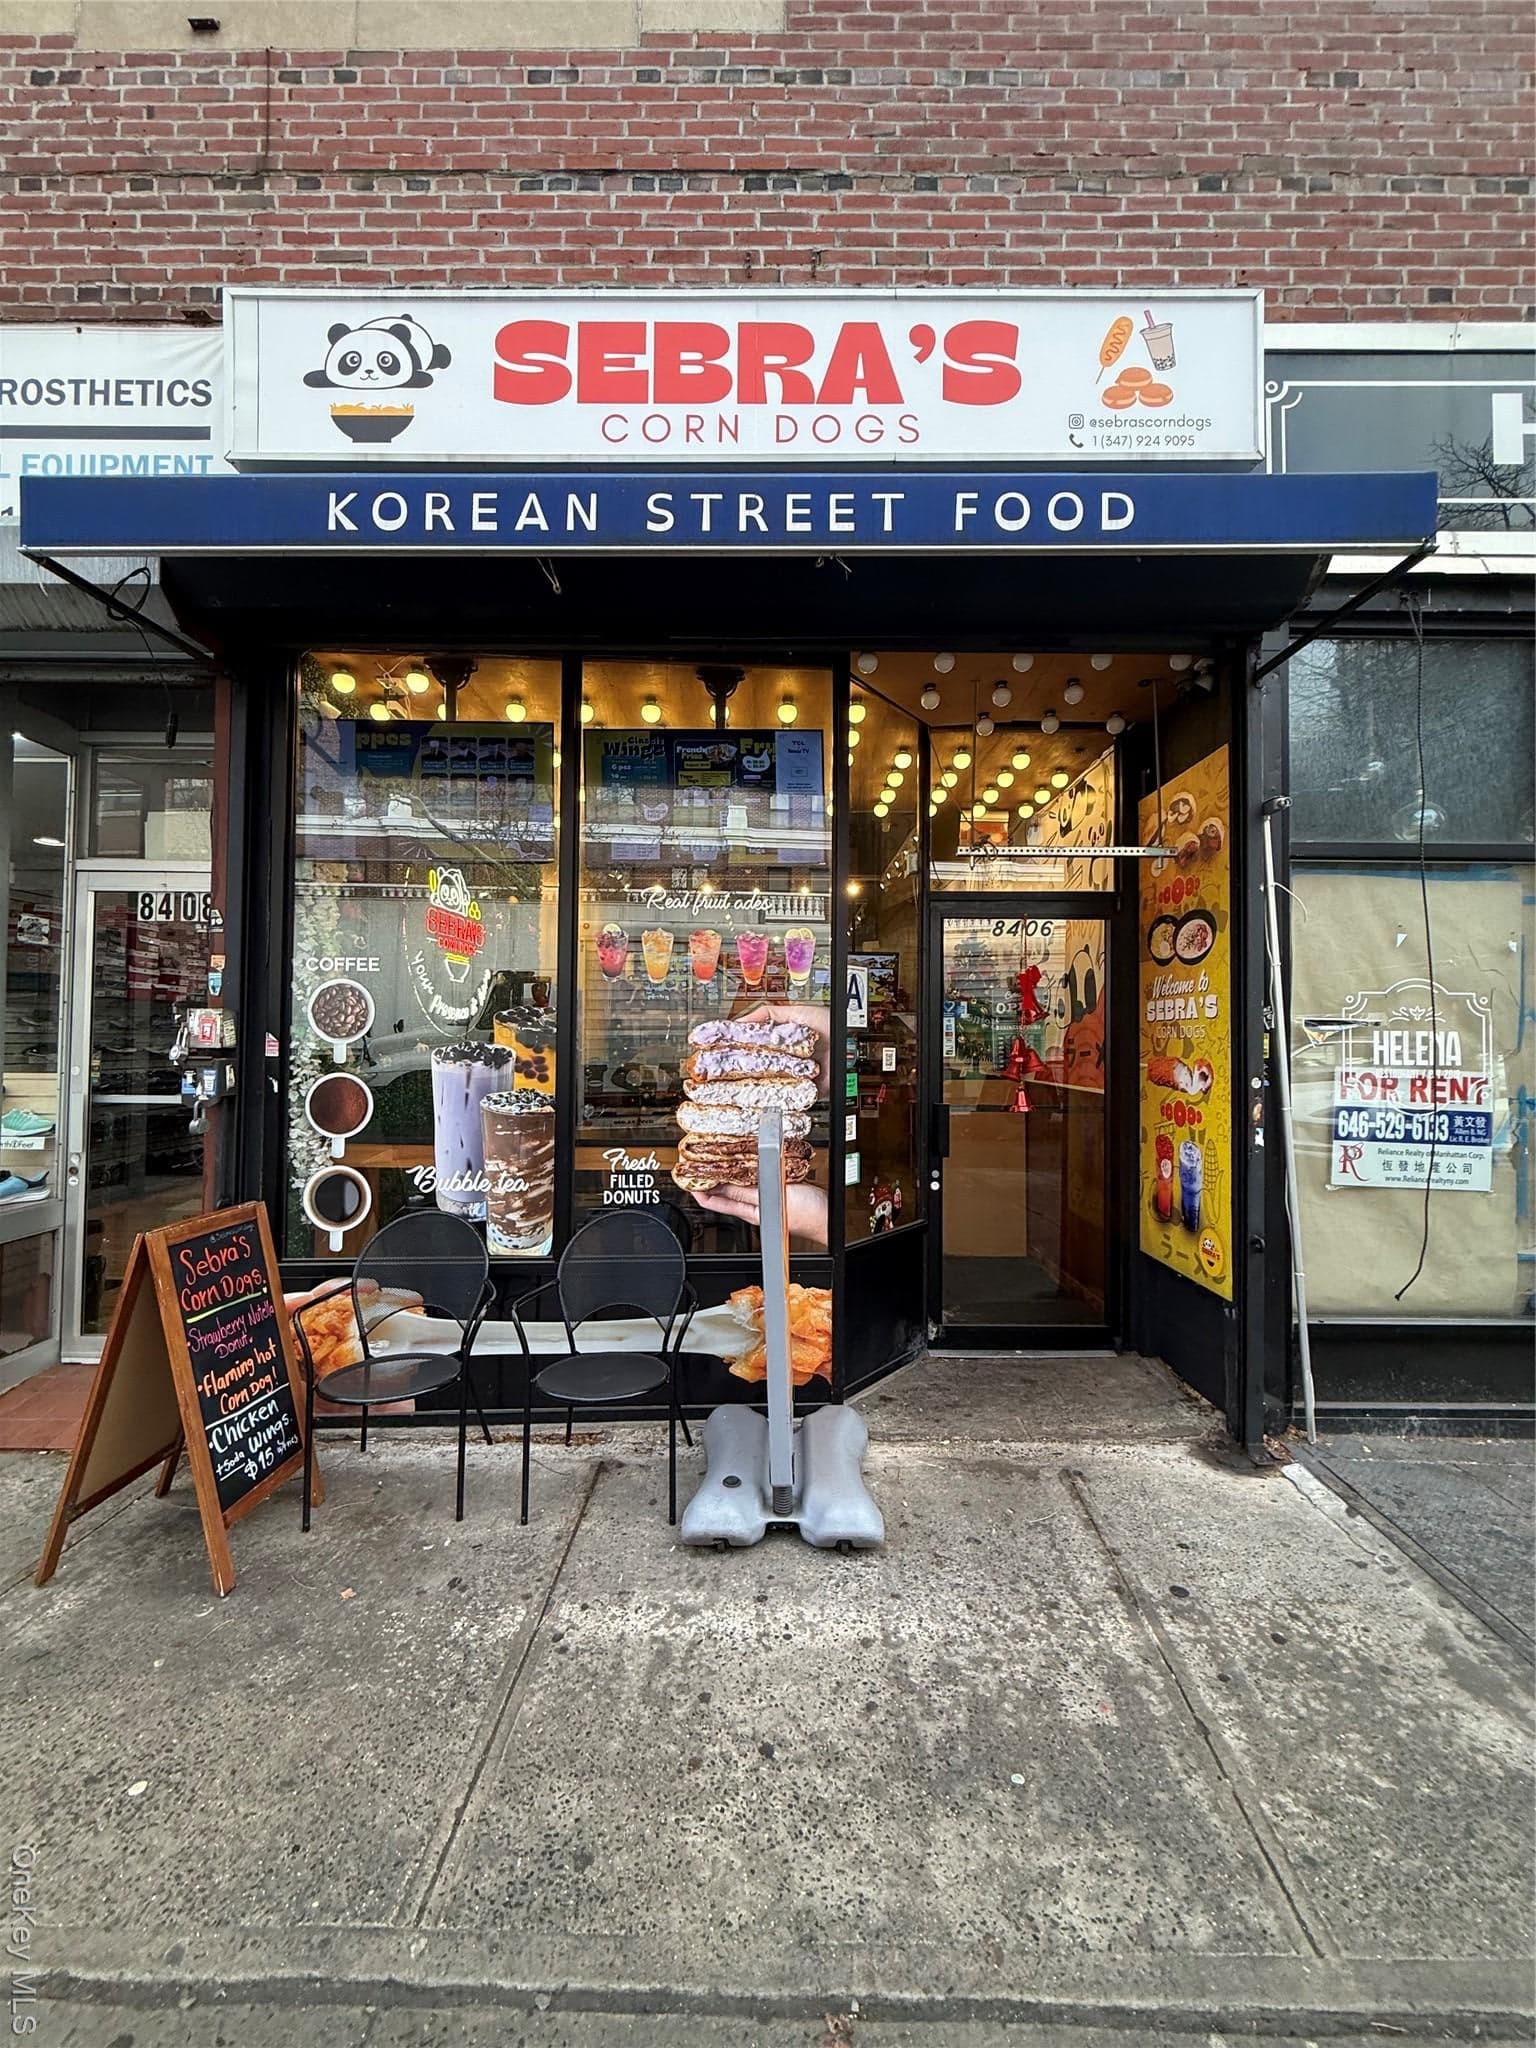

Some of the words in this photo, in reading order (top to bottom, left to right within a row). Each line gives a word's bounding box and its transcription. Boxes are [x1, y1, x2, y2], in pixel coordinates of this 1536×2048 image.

[494, 320, 1022, 406] SEBRA'S
[601, 414, 740, 443] CORN
[776, 414, 920, 444] DOGS
[1089, 415, 1212, 431] @sebrascorndogs
[1092, 435, 1098, 447] 1
[1101, 434, 1133, 449] (347)
[1136, 435, 1160, 447] 924
[1165, 435, 1195, 447] 9095
[22, 454, 214, 475] EQUIPMENT
[326, 492, 598, 531] KOREAN
[646, 493, 905, 532] STREET
[955, 492, 1136, 532] FOOD
[641, 887, 690, 910] Real
[691, 891, 732, 916] fruit
[734, 892, 772, 910] ades
[992, 920, 1054, 937] 8406
[305, 957, 381, 972] COFFEE
[847, 973, 863, 1010] A
[1151, 973, 1195, 998] Welcome
[1199, 969, 1209, 992] to
[1146, 993, 1219, 1022] SEBRA'S
[1179, 1025, 1207, 1039] DOGS
[1373, 1030, 1463, 1066] HELENA
[1340, 1071, 1399, 1101] FOR
[1409, 1077, 1489, 1106] RENT
[1337, 1111, 1449, 1141] 646-529-6133
[602, 1148, 660, 1172] Fresh
[1377, 1148, 1404, 1156] Reliance
[1405, 1149, 1424, 1158] Realty
[405, 1165, 491, 1193] Bubble
[492, 1168, 530, 1192] tea
[610, 1174, 655, 1189] FILLED
[603, 1190, 661, 1205] DONUTS
[179, 1236, 251, 1286] Sebra's
[181, 1285, 222, 1312] Corn
[188, 1316, 247, 1352] Strawberry
[256, 1337, 277, 1365] hot
[220, 1389, 250, 1415] Corn
[211, 1399, 280, 1454] Chicken
